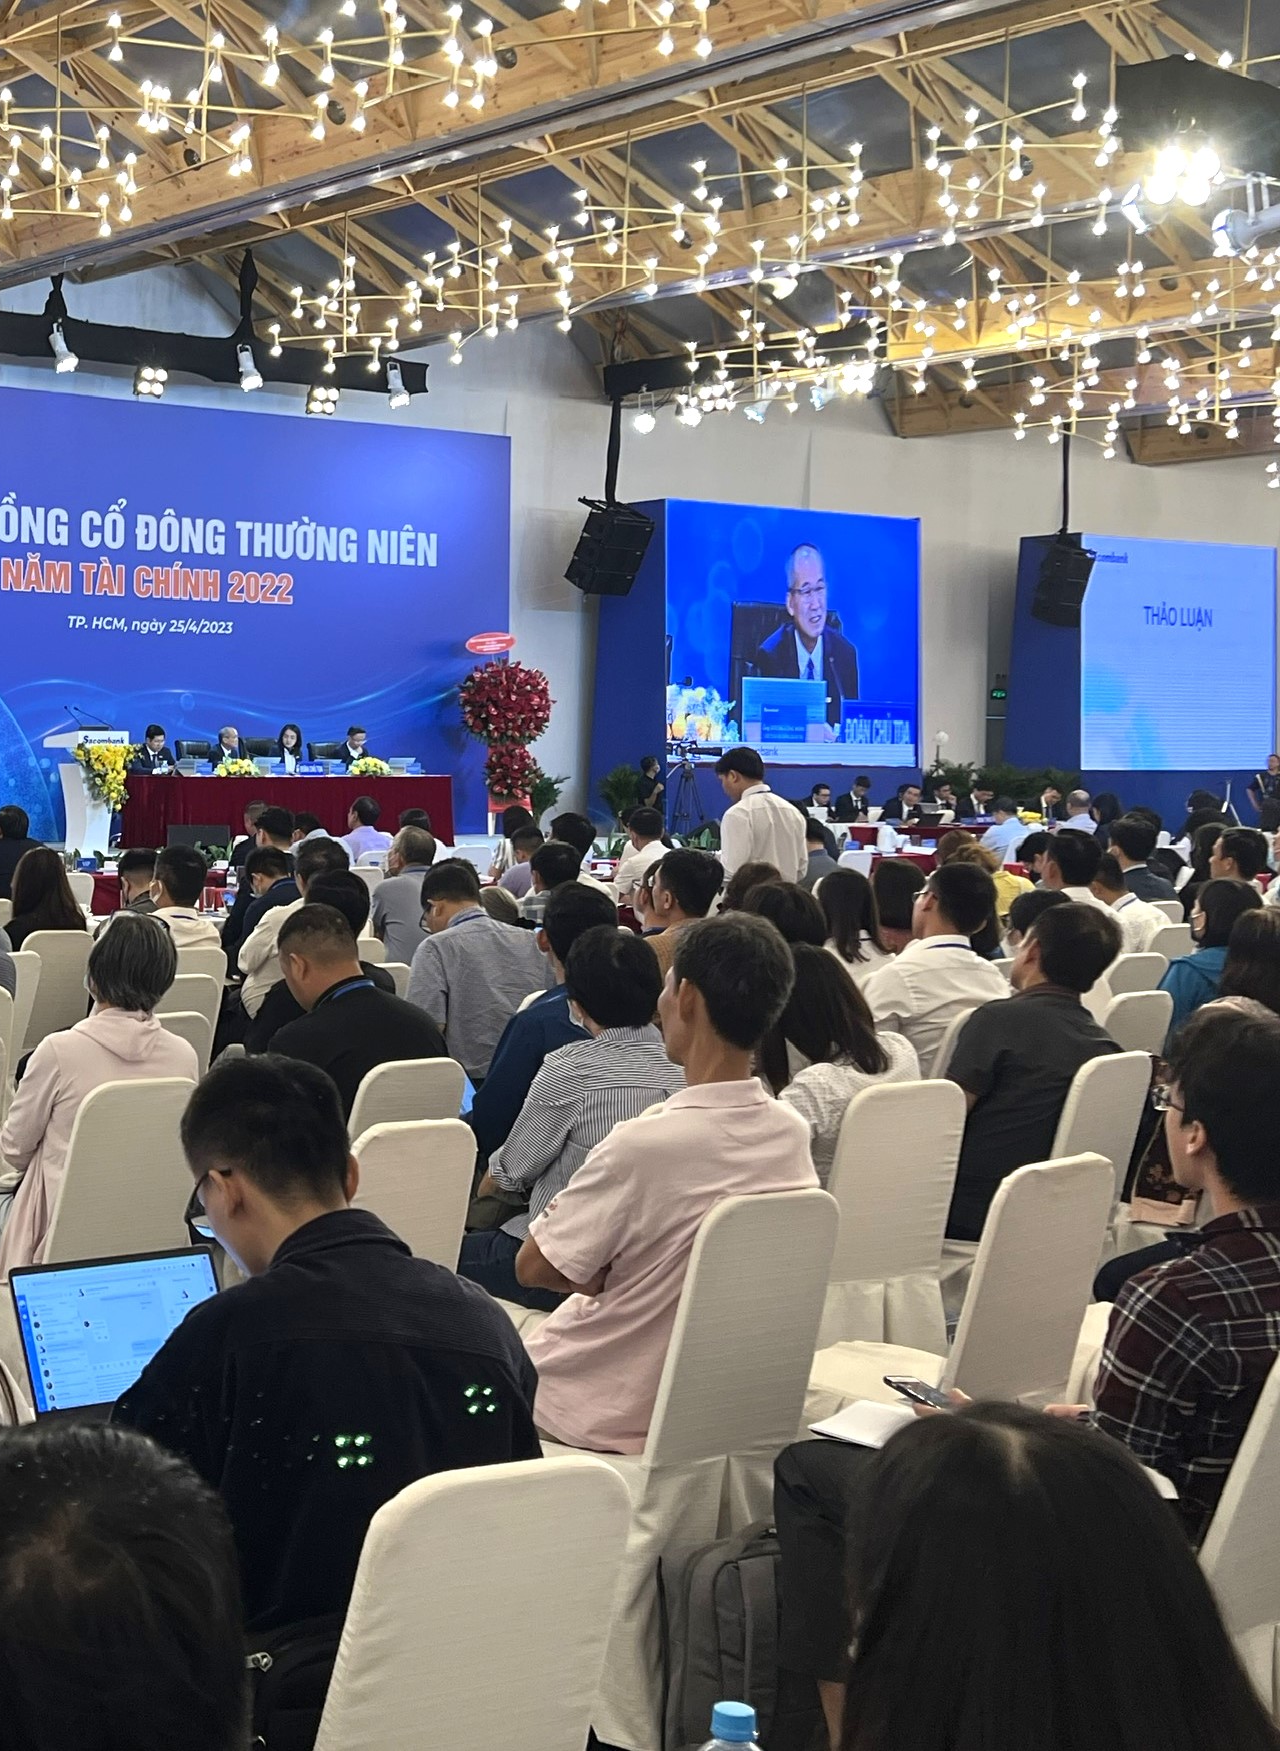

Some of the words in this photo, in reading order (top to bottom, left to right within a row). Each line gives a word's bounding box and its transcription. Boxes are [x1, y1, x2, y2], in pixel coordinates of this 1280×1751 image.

[80, 498, 128, 550] CỔ
[135, 508, 226, 556] ĐÔNG
[235, 516, 358, 564] THƯỜNG
[367, 524, 438, 568] NIÊN
[0, 552, 72, 594] NĂM
[79, 556, 126, 597] TÀI
[133, 561, 221, 602] CHÍNH
[227, 570, 294, 605] 2022
[67, 615, 88, 630] TP.
[91, 617, 128, 633] HCM,
[131, 618, 167, 635] ngày
[169, 618, 234, 636] 25/4/2023
[1143, 601, 1177, 626] THẢO
[1180, 607, 1213, 632] LUẬN
[83, 735, 125, 745] Sacombank
